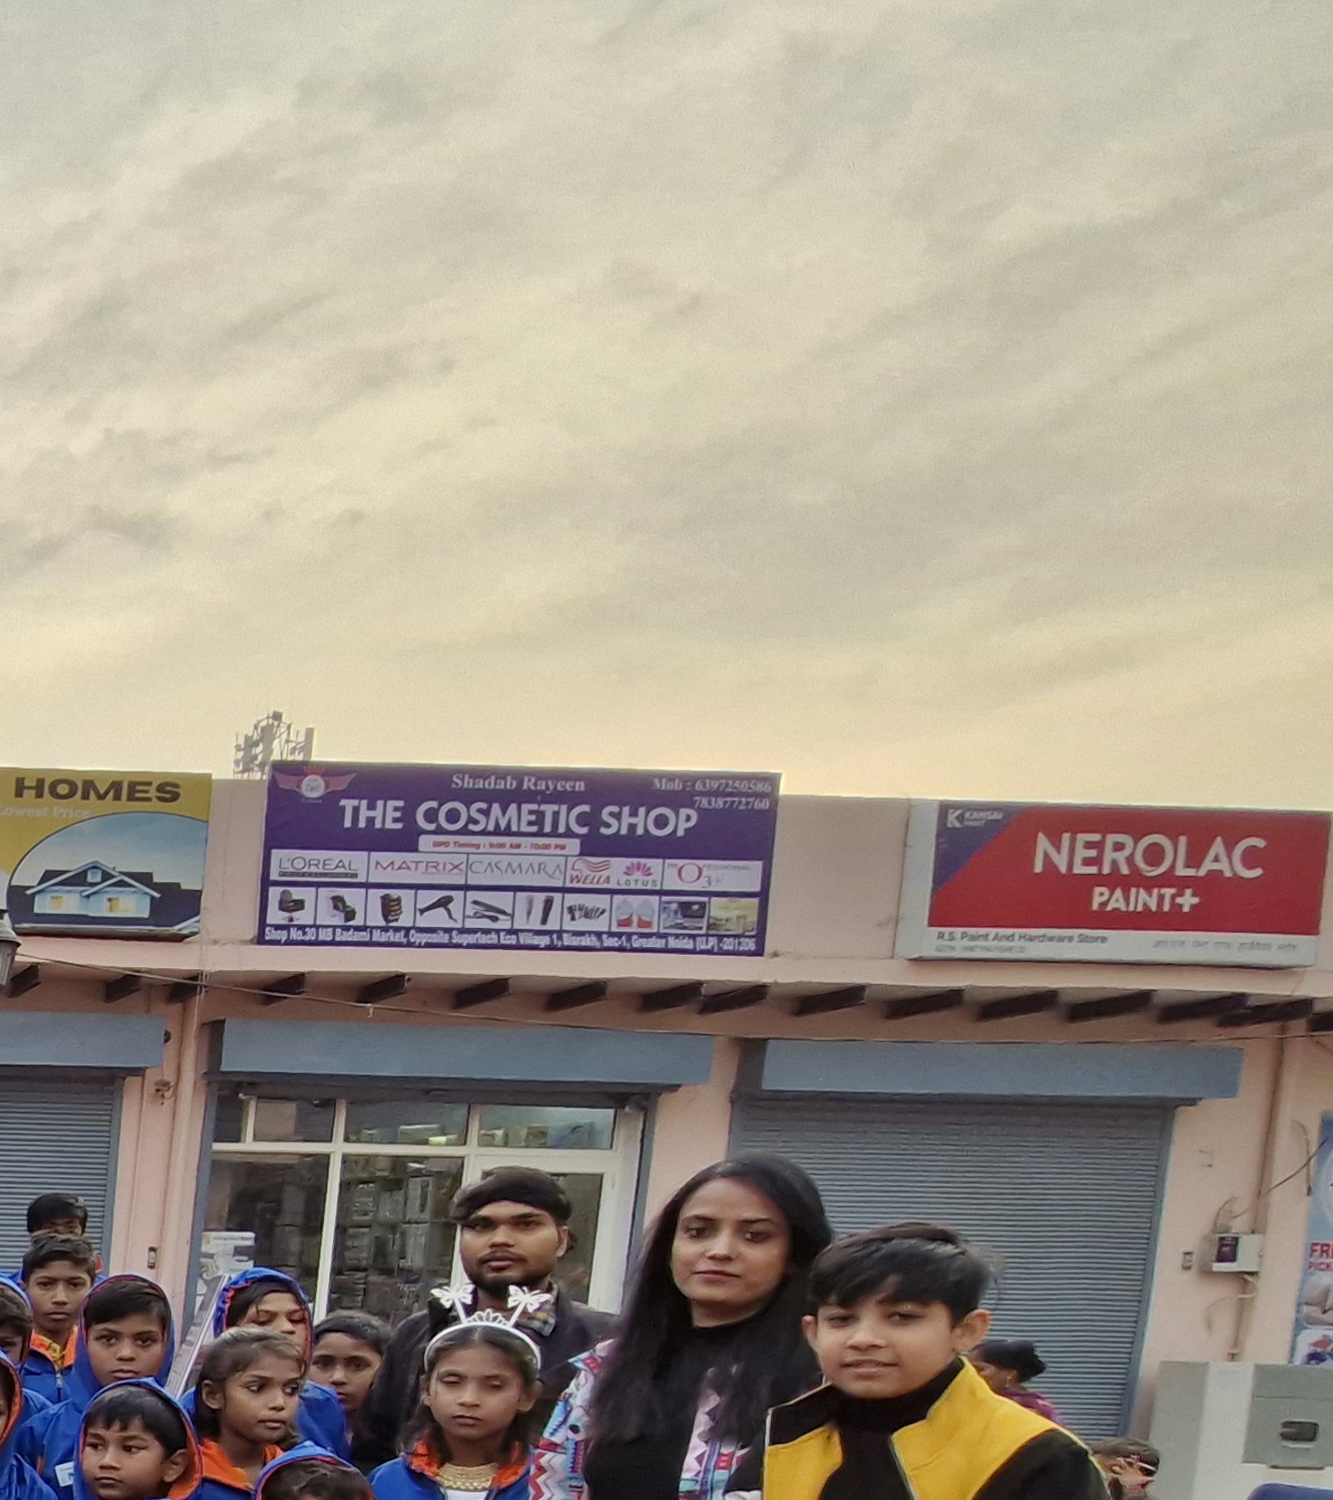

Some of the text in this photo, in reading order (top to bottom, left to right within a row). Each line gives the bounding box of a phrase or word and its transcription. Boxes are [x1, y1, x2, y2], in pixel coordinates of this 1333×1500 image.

[14, 777, 182, 803] HOMES
[451, 773, 585, 794] Shadab Rayeen
[653, 778, 683, 791] Mob
[339, 799, 699, 838] THE COSMETIC SHOP
[1033, 831, 1268, 879] NEROLAC
[374, 861, 465, 873] MATRIX
[469, 861, 563, 880] CASMARA
[569, 873, 611, 886] WELLA
[616, 879, 658, 888] LOTUS
[1091, 886, 1201, 914] PAINT+
[264, 926, 287, 944] Shop
[318, 928, 333, 941] MB
[335, 929, 370, 942] Badami
[372, 930, 407, 945] Market,
[409, 930, 449, 947] Opposite
[500, 932, 517, 945] Eco
[519, 932, 551, 949] Village
[631, 935, 665, 949] Greater
[667, 936, 694, 950] Noida
[960, 932, 989, 942] Paint
[991, 933, 1016, 942] And
[1018, 933, 1074, 944] Hardware
[1077, 934, 1108, 944] Store
[1310, 1242, 1333, 1259] FR
